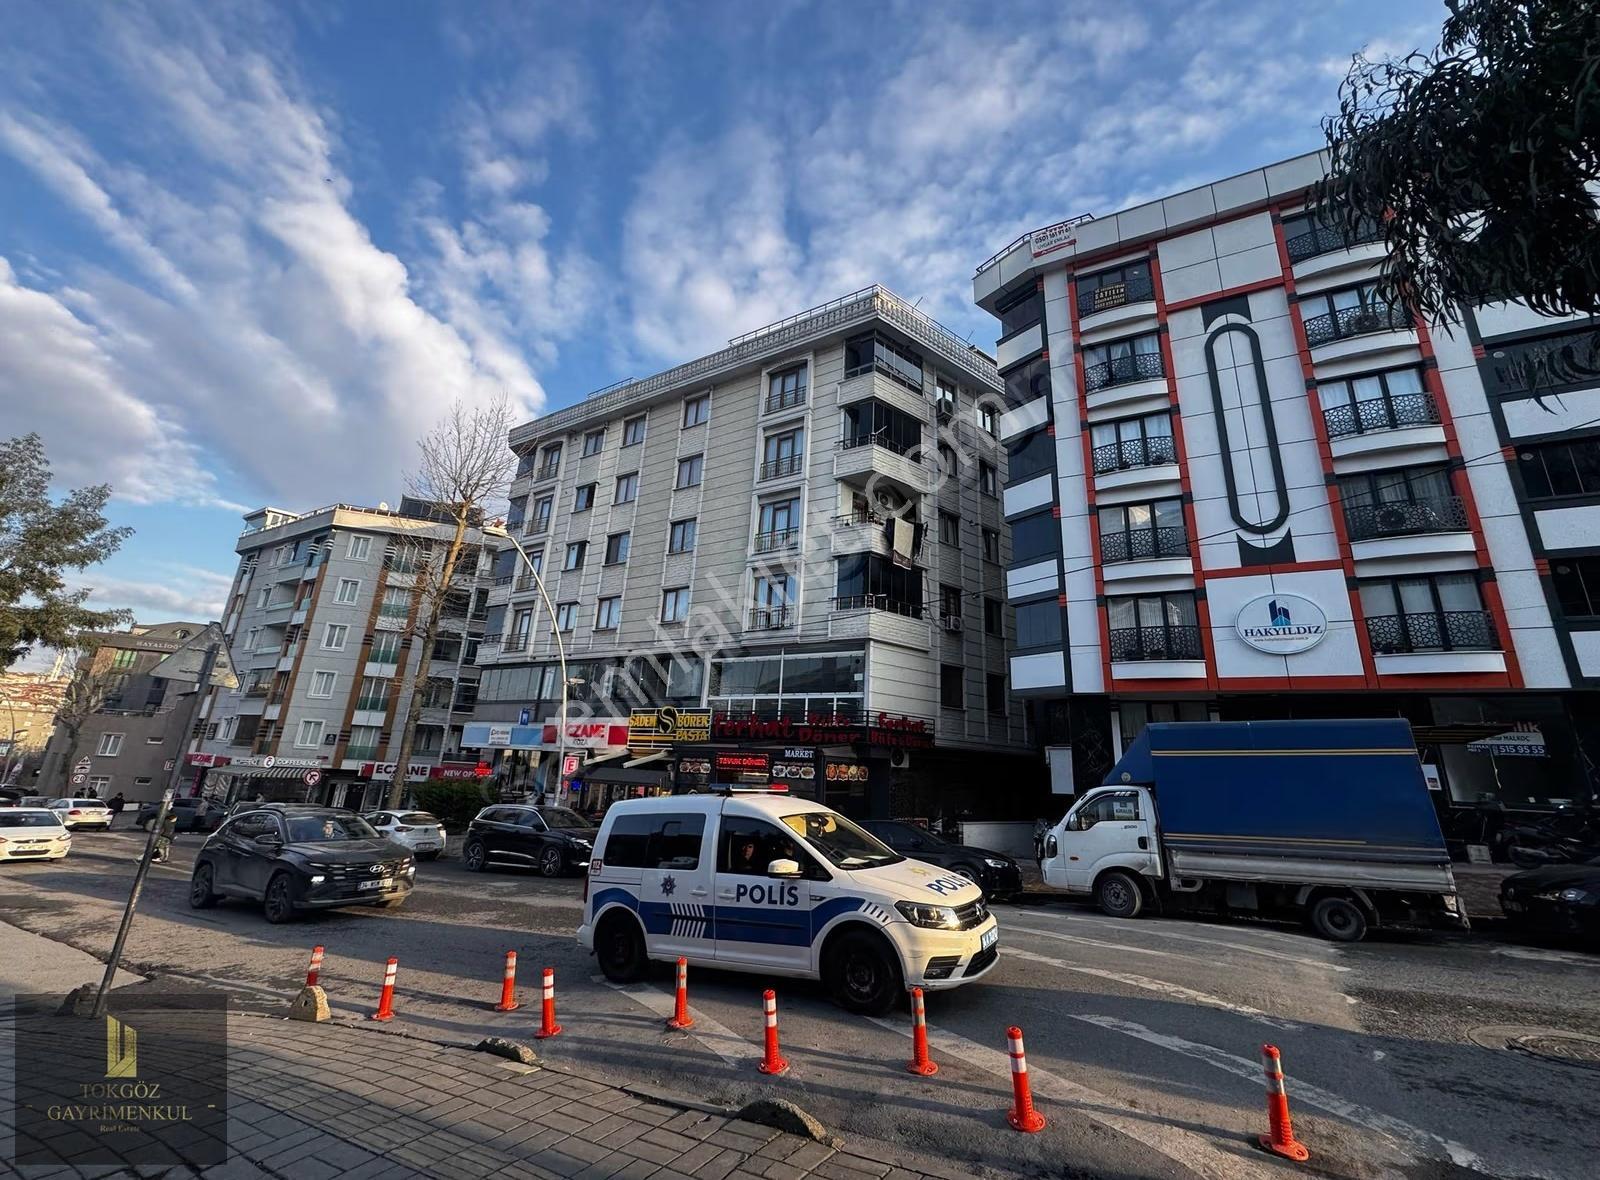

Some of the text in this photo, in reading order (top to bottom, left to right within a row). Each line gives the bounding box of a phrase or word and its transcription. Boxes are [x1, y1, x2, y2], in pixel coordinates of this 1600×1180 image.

[1244, 625, 1323, 637] HAKYILDIZ
[565, 724, 605, 738] CZANE
[676, 730, 710, 741] PASTA
[784, 749, 814, 759] MARKET
[1499, 745, 1516, 753] 515
[1517, 746, 1530, 754] 95
[1531, 746, 1545, 754] 55
[376, 764, 428, 775] ECNE
[926, 875, 972, 896] POLİS
[736, 881, 799, 906] POLİS
